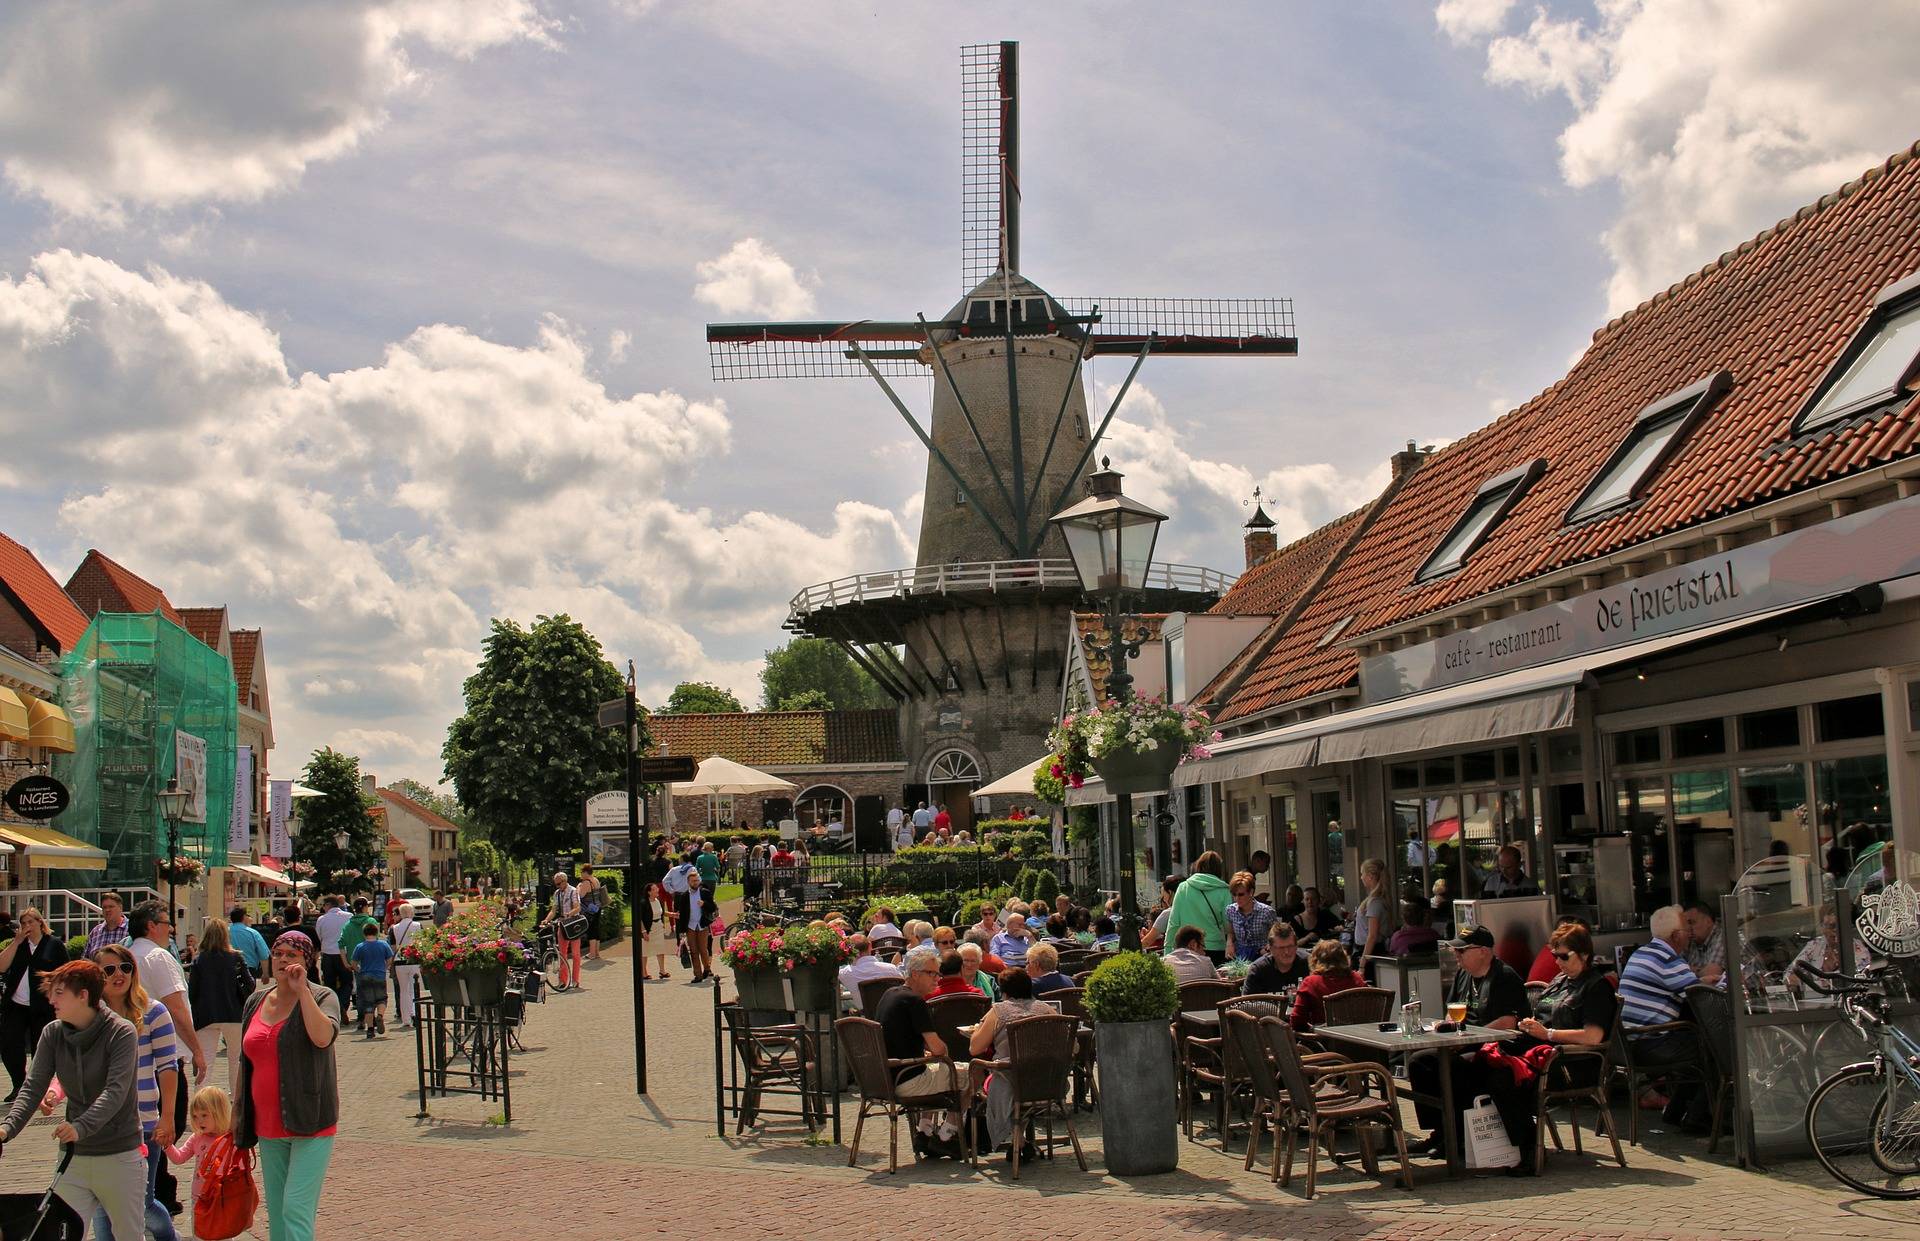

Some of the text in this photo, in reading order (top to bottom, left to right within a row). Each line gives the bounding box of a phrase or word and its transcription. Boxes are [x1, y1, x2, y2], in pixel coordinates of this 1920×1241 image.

[1445, 640, 1471, 669] café
[1489, 620, 1561, 657] restaurant
[19, 791, 58, 805] INGES
